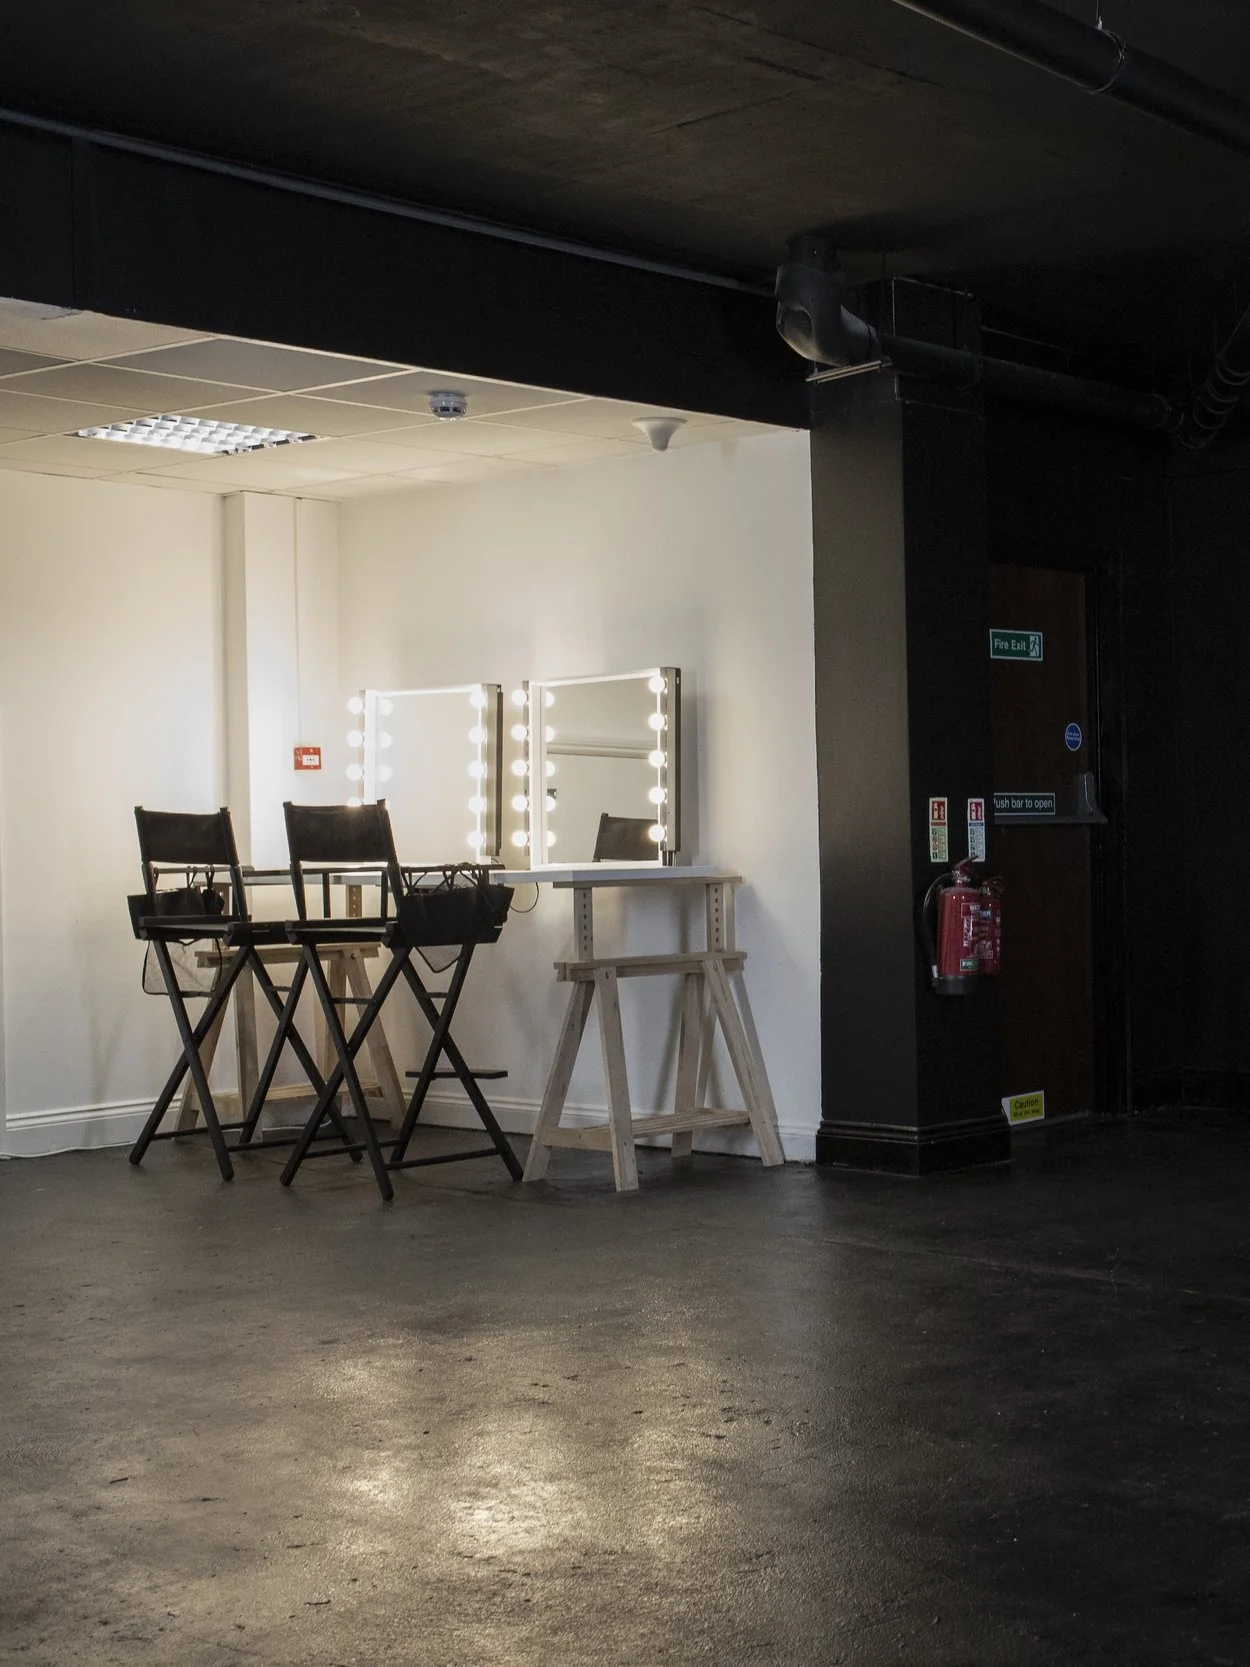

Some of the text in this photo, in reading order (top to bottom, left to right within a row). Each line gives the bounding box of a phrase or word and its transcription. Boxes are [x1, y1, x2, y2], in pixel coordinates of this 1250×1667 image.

[994, 638, 1026, 651] Fire Exit
[1011, 797, 1023, 809] bar
[1025, 797, 1033, 809] to
[1034, 799, 1053, 811] open
[1014, 1098, 1039, 1109] Caution
